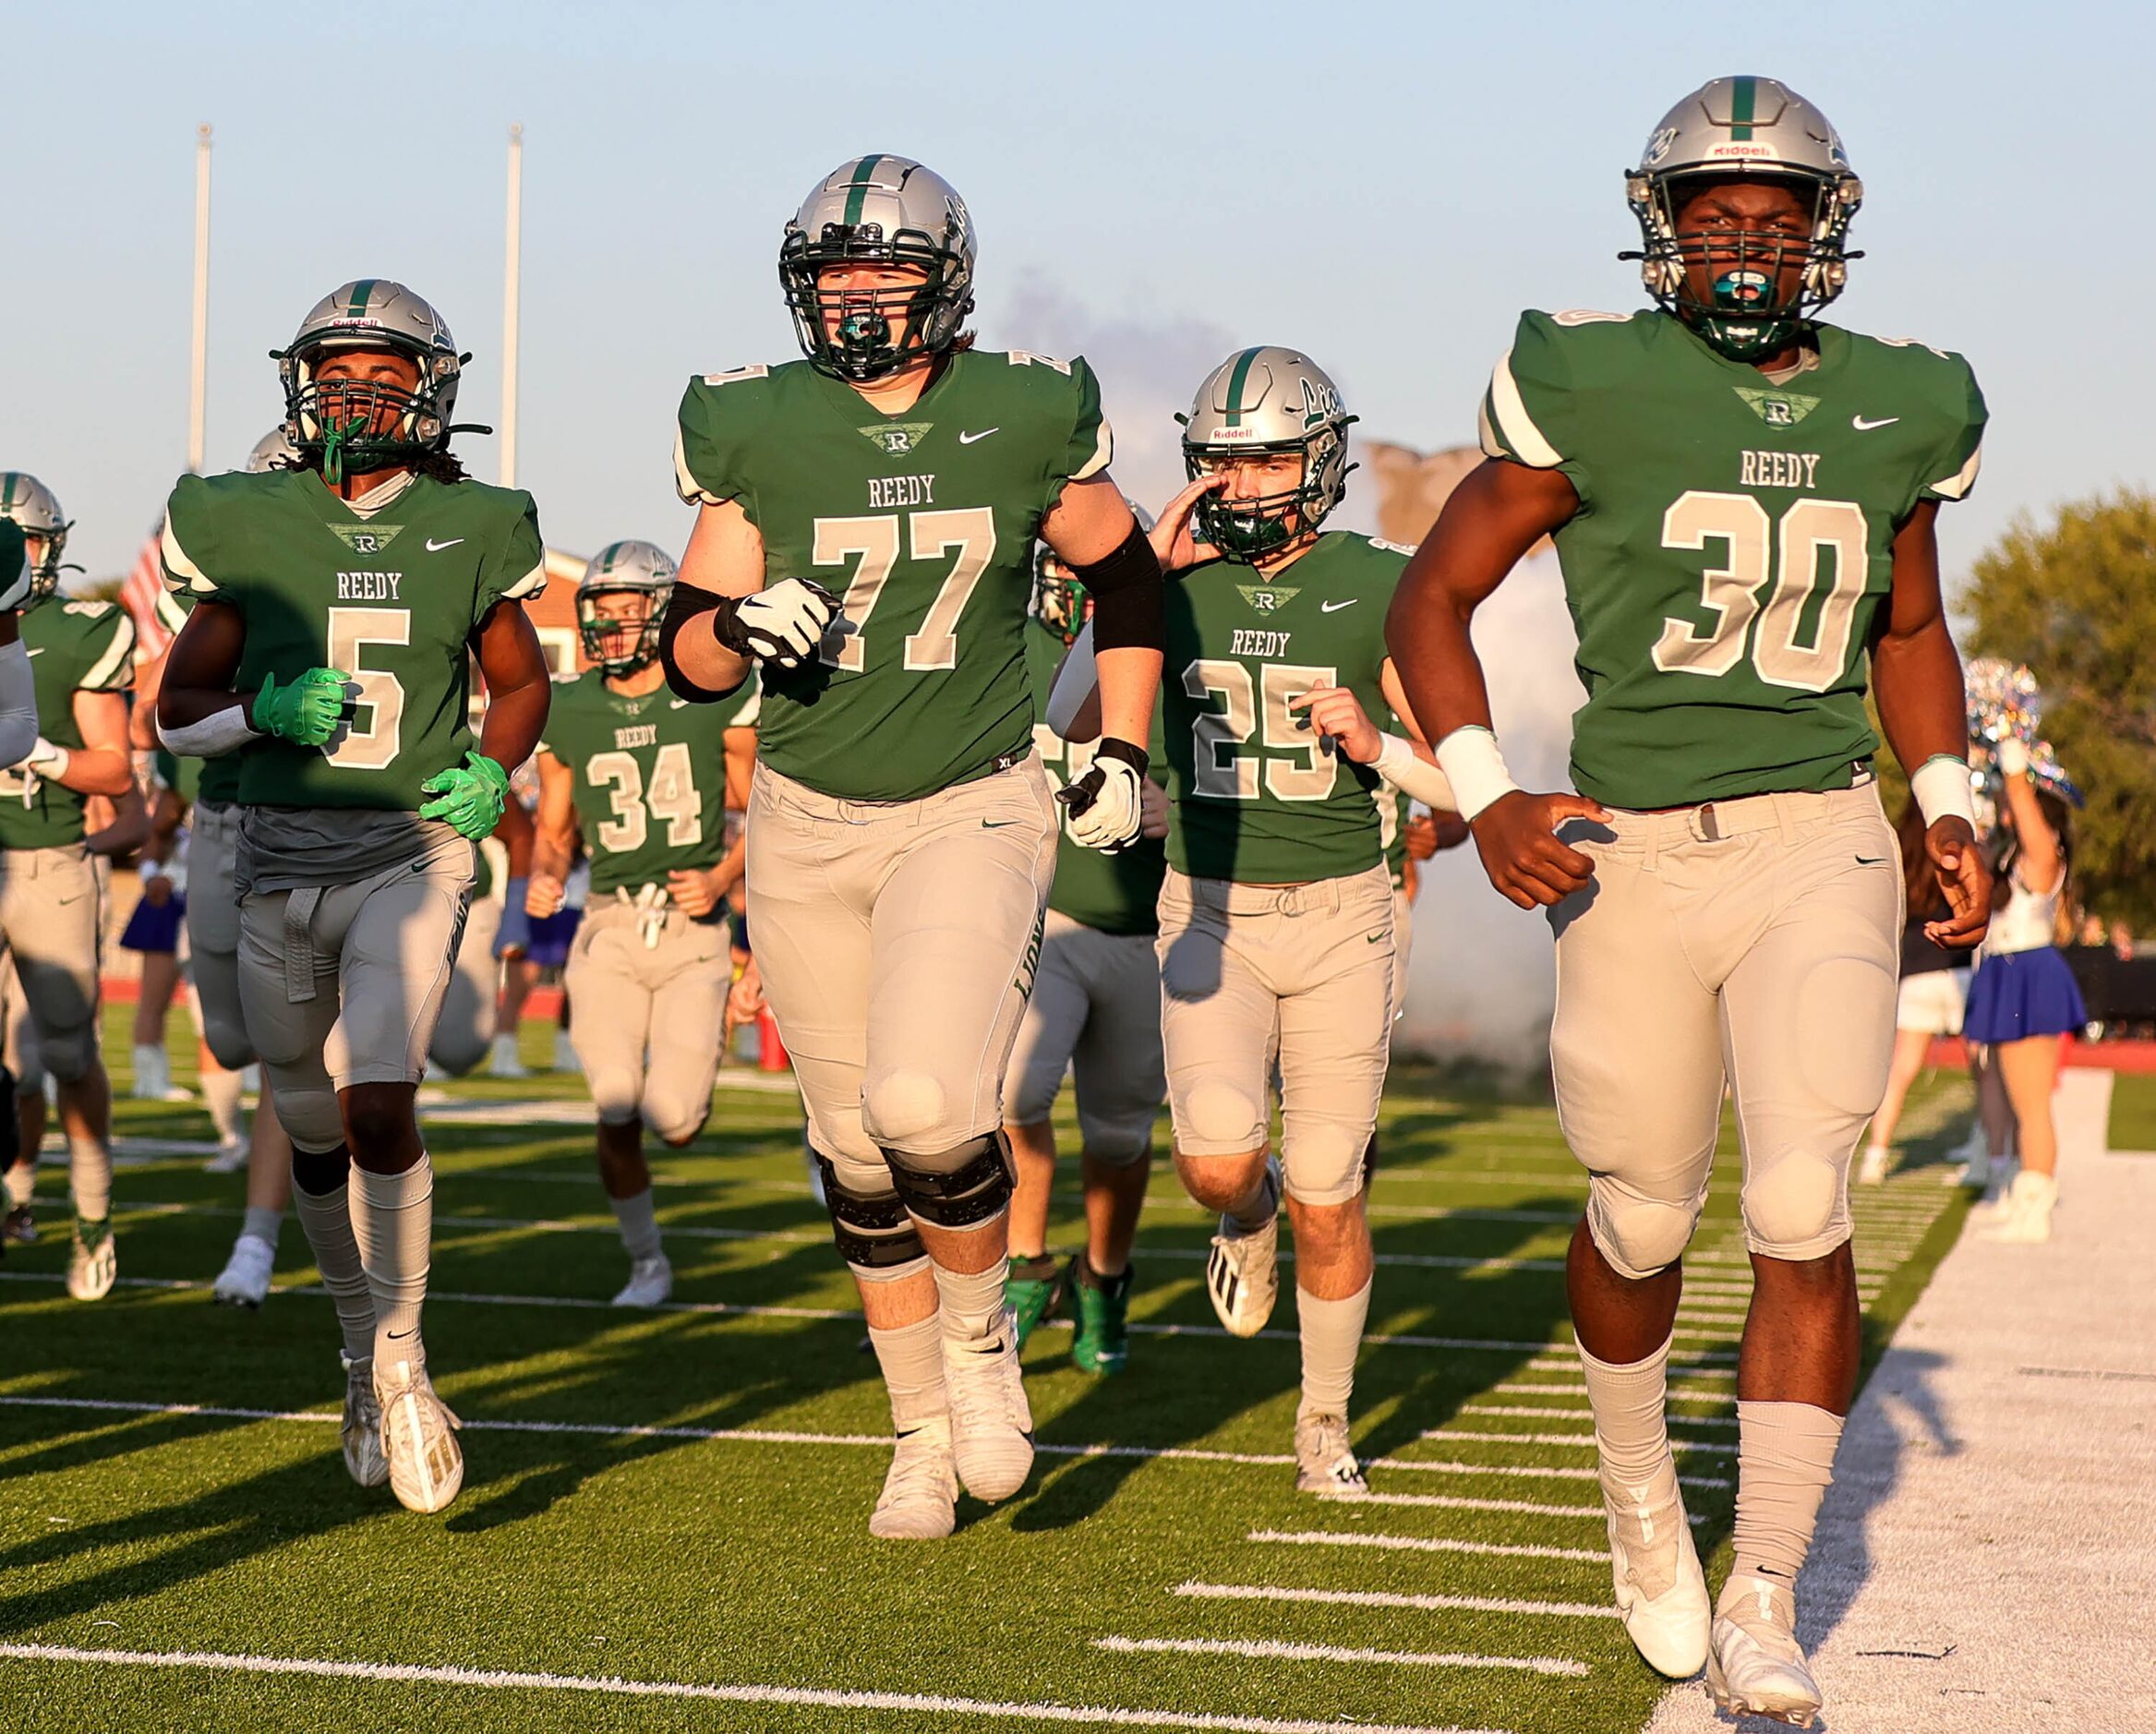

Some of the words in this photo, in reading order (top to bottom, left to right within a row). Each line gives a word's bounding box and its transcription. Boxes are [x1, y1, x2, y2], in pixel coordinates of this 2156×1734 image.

[1299, 377, 1346, 432] Lio
[885, 432, 910, 452] R
[1213, 428, 1253, 440] Riddell
[1740, 450, 1820, 489] REEDY
[867, 474, 936, 508] REEDY
[336, 572, 403, 600] REEDY
[813, 506, 997, 673] 77
[1254, 592, 1276, 611] R
[1651, 490, 1869, 693] 30
[1230, 629, 1291, 657] REEDY
[320, 606, 412, 770] 5
[614, 723, 657, 750] REEDY
[1181, 658, 1338, 801] 25
[998, 757, 1012, 769] XL
[585, 742, 703, 853] 34
